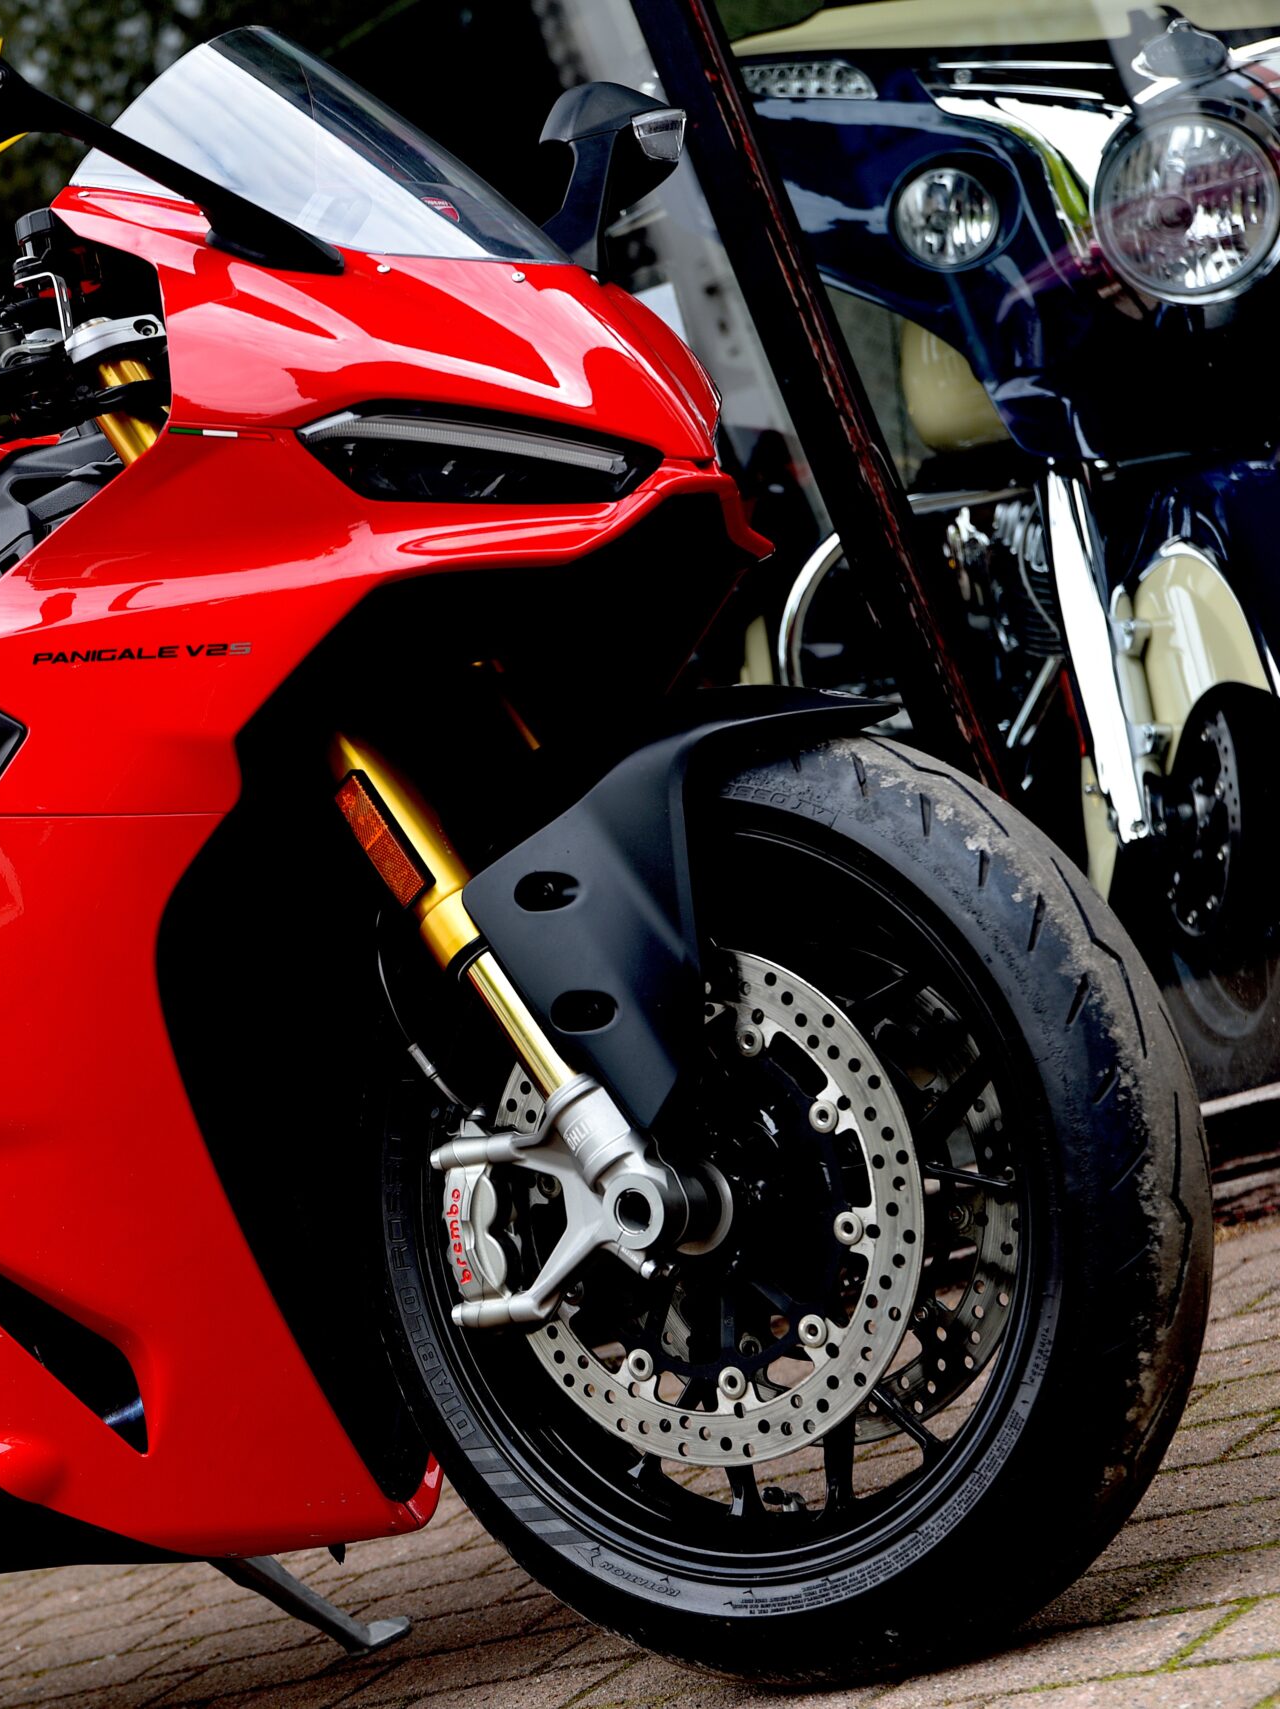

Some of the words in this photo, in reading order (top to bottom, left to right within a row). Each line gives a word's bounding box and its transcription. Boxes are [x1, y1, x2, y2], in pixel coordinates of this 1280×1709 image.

[32, 645, 180, 666] PANIGALE
[185, 641, 252, 657] V2S
[446, 1188, 473, 1285] brembo
[399, 1286, 477, 1441] DIABLO
[599, 1561, 681, 1598] ROTATION
